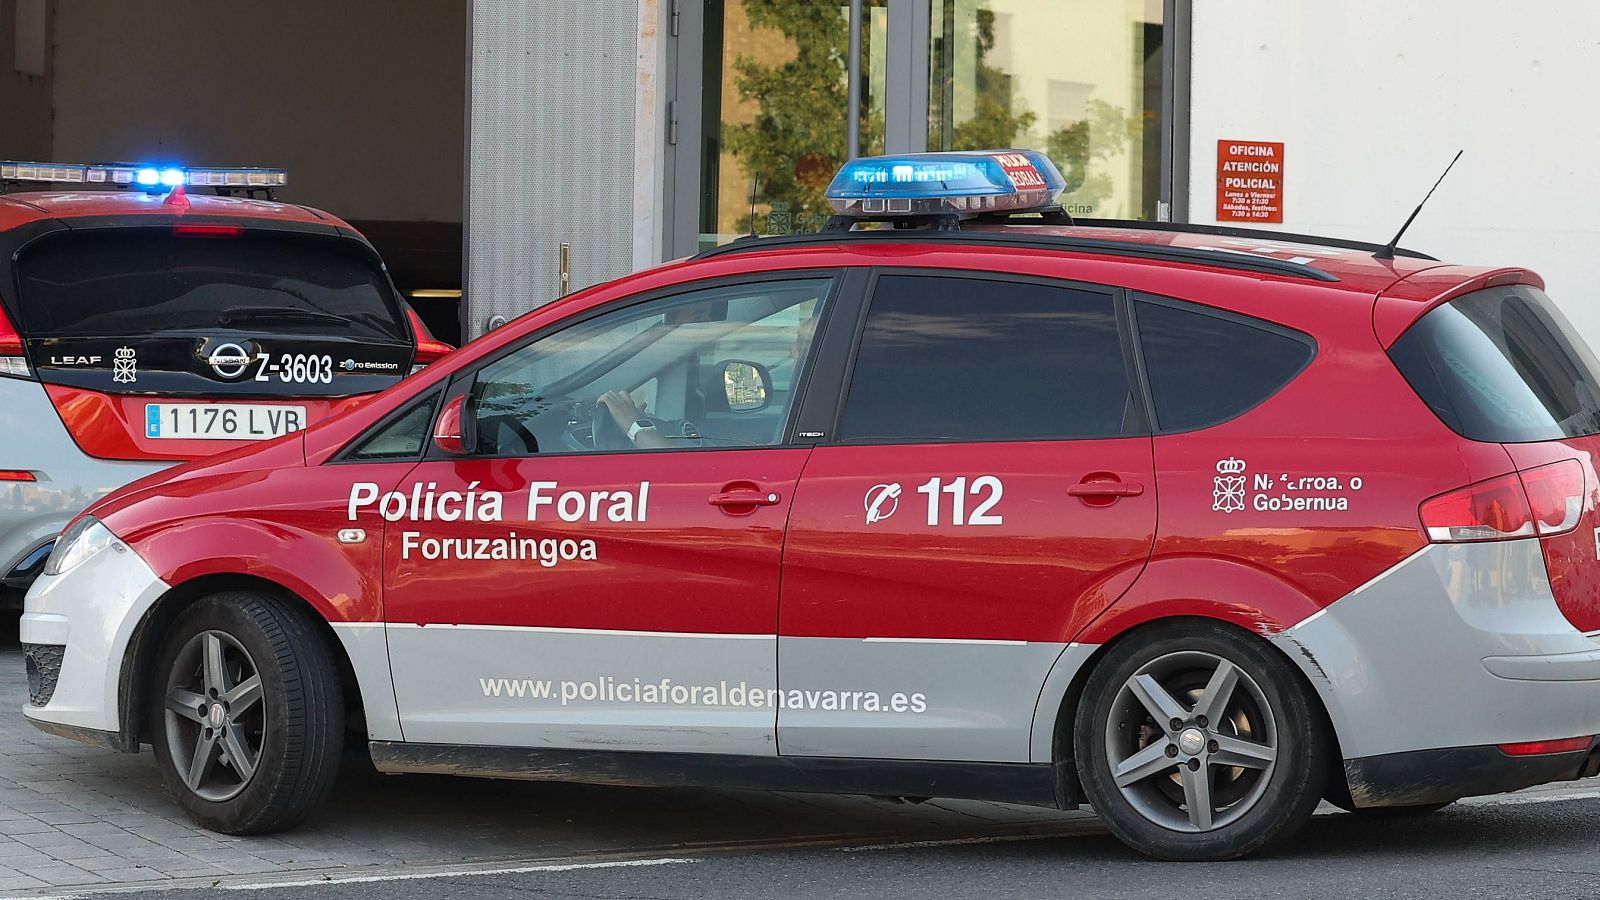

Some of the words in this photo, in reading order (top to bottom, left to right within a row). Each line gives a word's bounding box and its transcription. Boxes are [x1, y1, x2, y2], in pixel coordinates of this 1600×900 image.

[1229, 145, 1274, 157] OFICINA
[1223, 160, 1279, 173] ATENCIÓN
[1225, 177, 1276, 189] POLICIAL
[51, 356, 102, 365] LEAF
[255, 353, 333, 384] Z-3603
[364, 361, 398, 369] Emission
[171, 408, 237, 434] 1176
[250, 409, 300, 435] LVB
[348, 481, 504, 522] Policía
[527, 481, 650, 522] Foral
[917, 475, 1004, 526] 112
[1253, 493, 1348, 511] Gobernua
[402, 531, 598, 568] Foruzaingoa
[479, 676, 928, 713] www.policiaforaldenavarra.es
